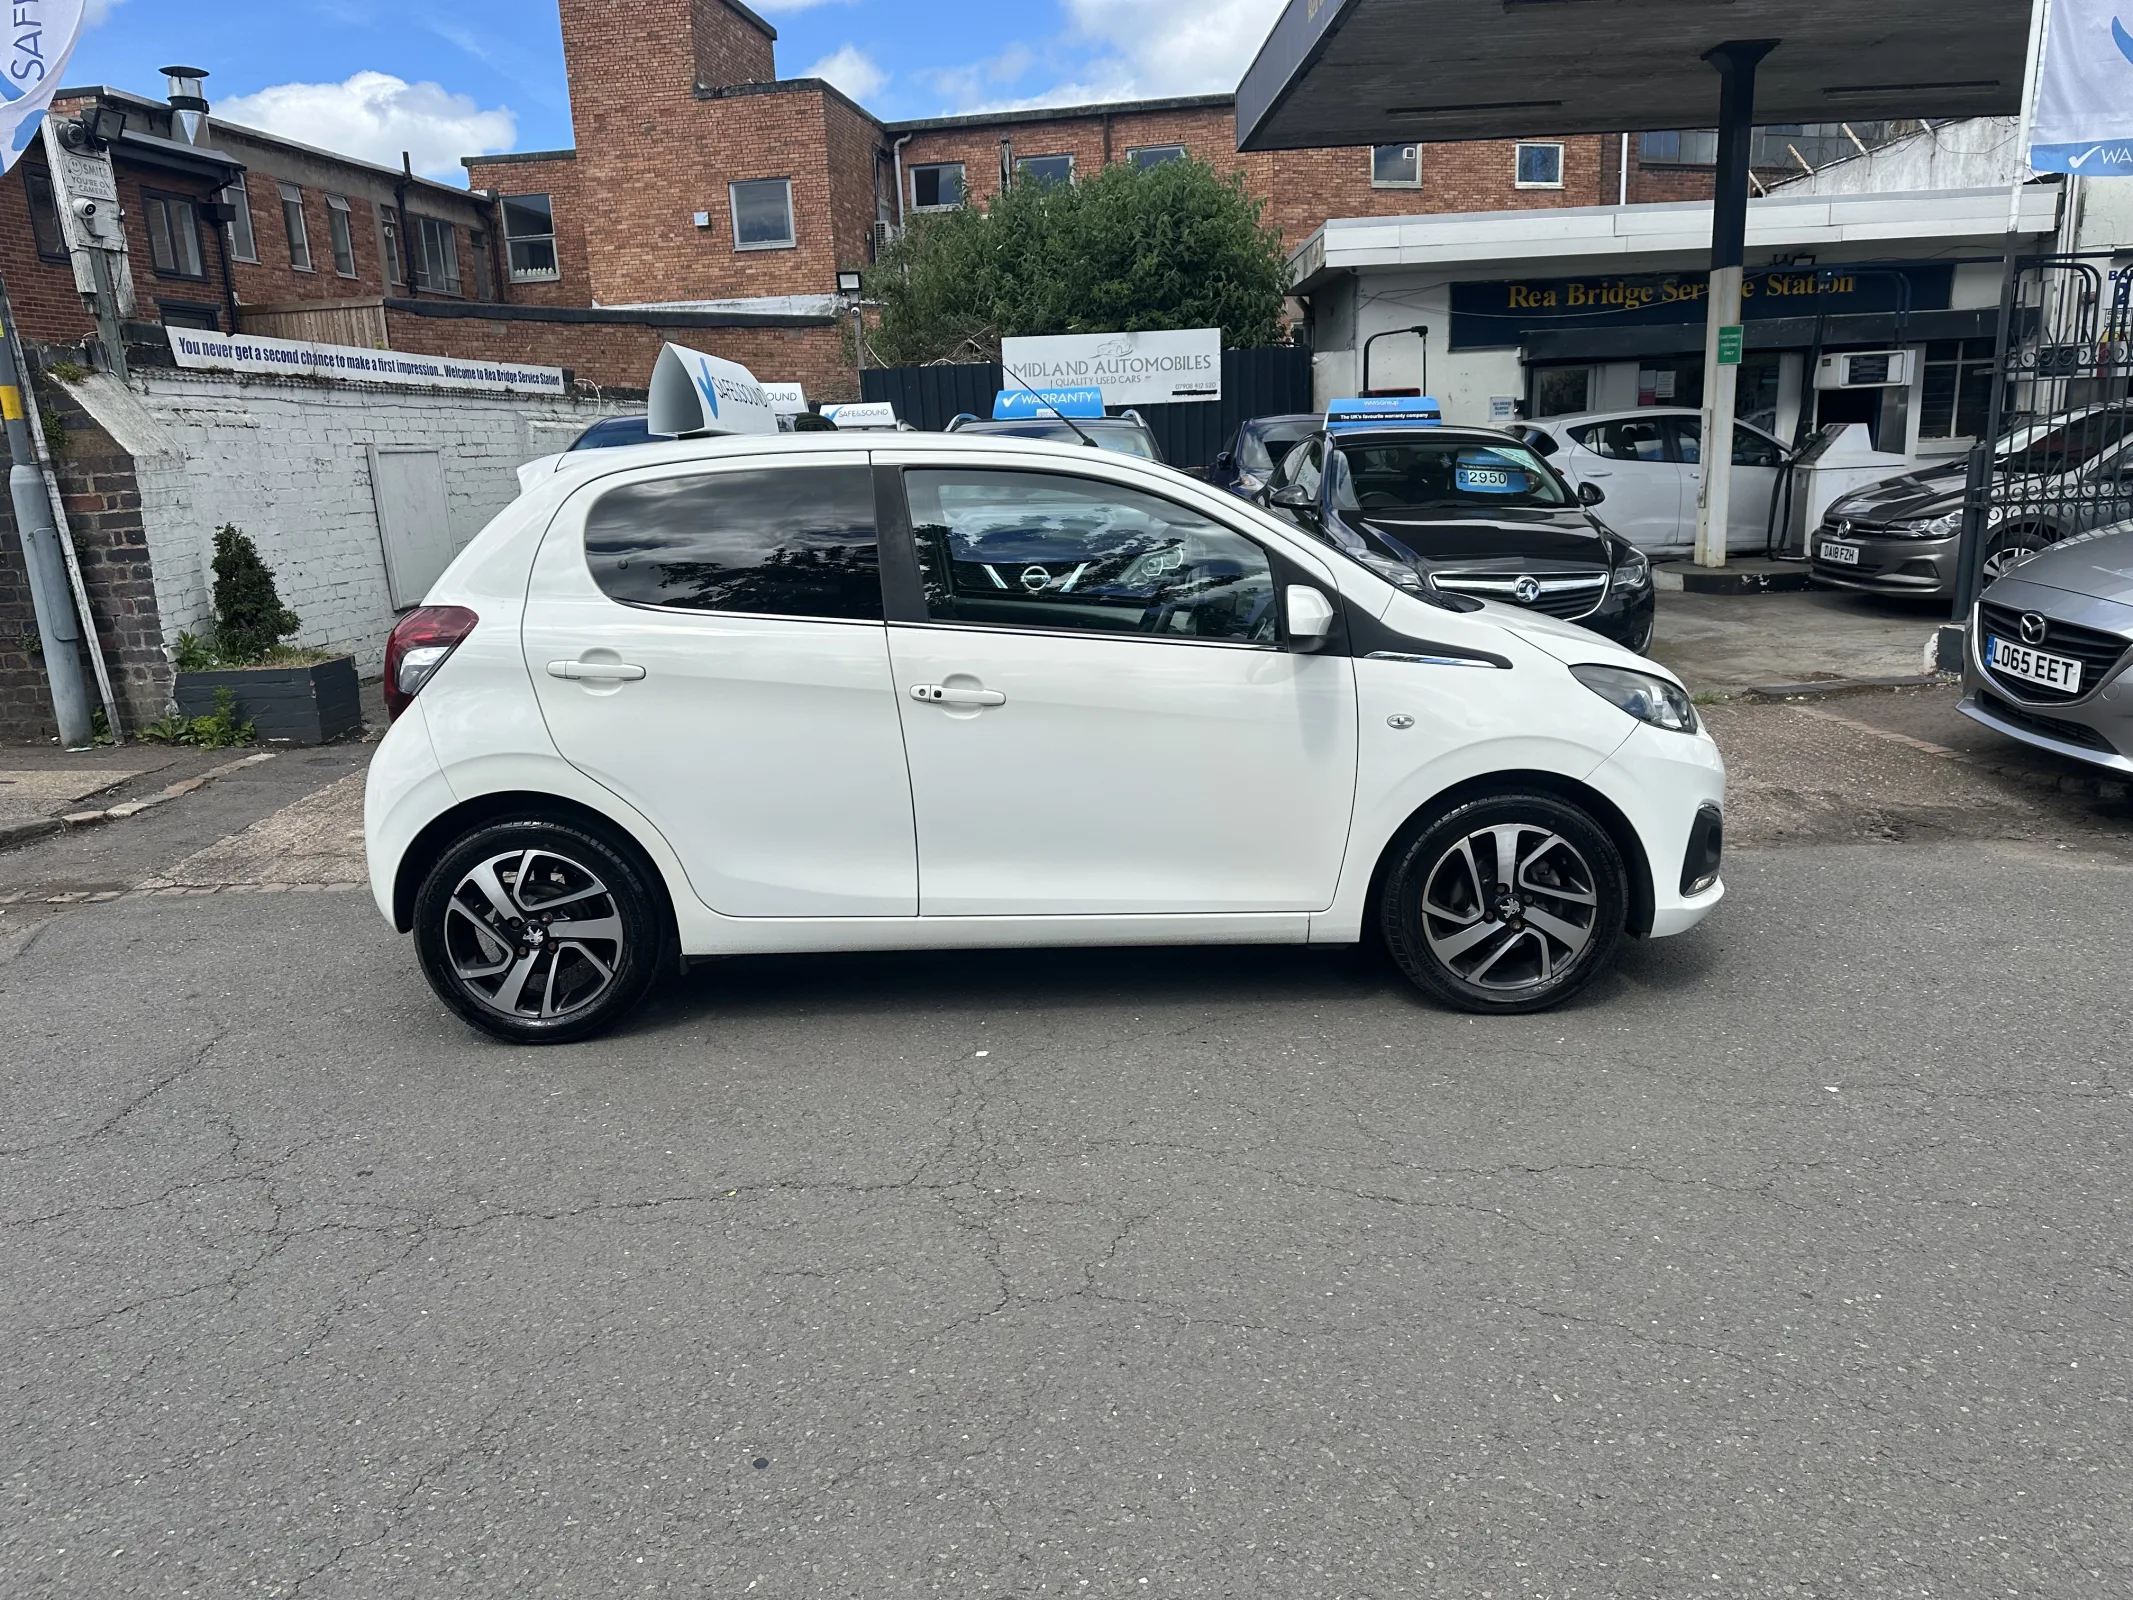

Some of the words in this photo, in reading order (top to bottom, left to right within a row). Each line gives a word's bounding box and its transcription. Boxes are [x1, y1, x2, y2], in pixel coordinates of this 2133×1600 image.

[10, 0, 46, 82] SAF
[1508, 285, 1557, 308] Rea
[1566, 281, 1653, 310] Bridge
[178, 336, 201, 356] You
[202, 340, 233, 359] never
[235, 344, 254, 361] get
[255, 348, 262, 361] a
[263, 349, 299, 365] second
[300, 350, 335, 367] chance
[336, 354, 346, 368] to
[347, 355, 371, 371] make
[372, 360, 378, 371] a
[378, 358, 396, 373] first
[444, 364, 477, 380] Welcome
[476, 368, 484, 381] to
[485, 369, 497, 382] Rea
[497, 369, 518, 384] Bridge
[518, 371, 540, 385] Service
[540, 372, 560, 386] Station
[1013, 360, 1089, 378] MIDLAND
[1094, 354, 1212, 375] AUTOMOBILES
[1055, 376, 1094, 387] QUALITY
[1096, 375, 1117, 385] USED
[1118, 374, 1142, 384] CARS
[1020, 391, 1094, 406] WARRANTY
[838, 408, 889, 418] SAFE&SOUND
[1824, 544, 1839, 559] DA18
[1840, 546, 1855, 562] FZH
[2034, 654, 2074, 686] EET
